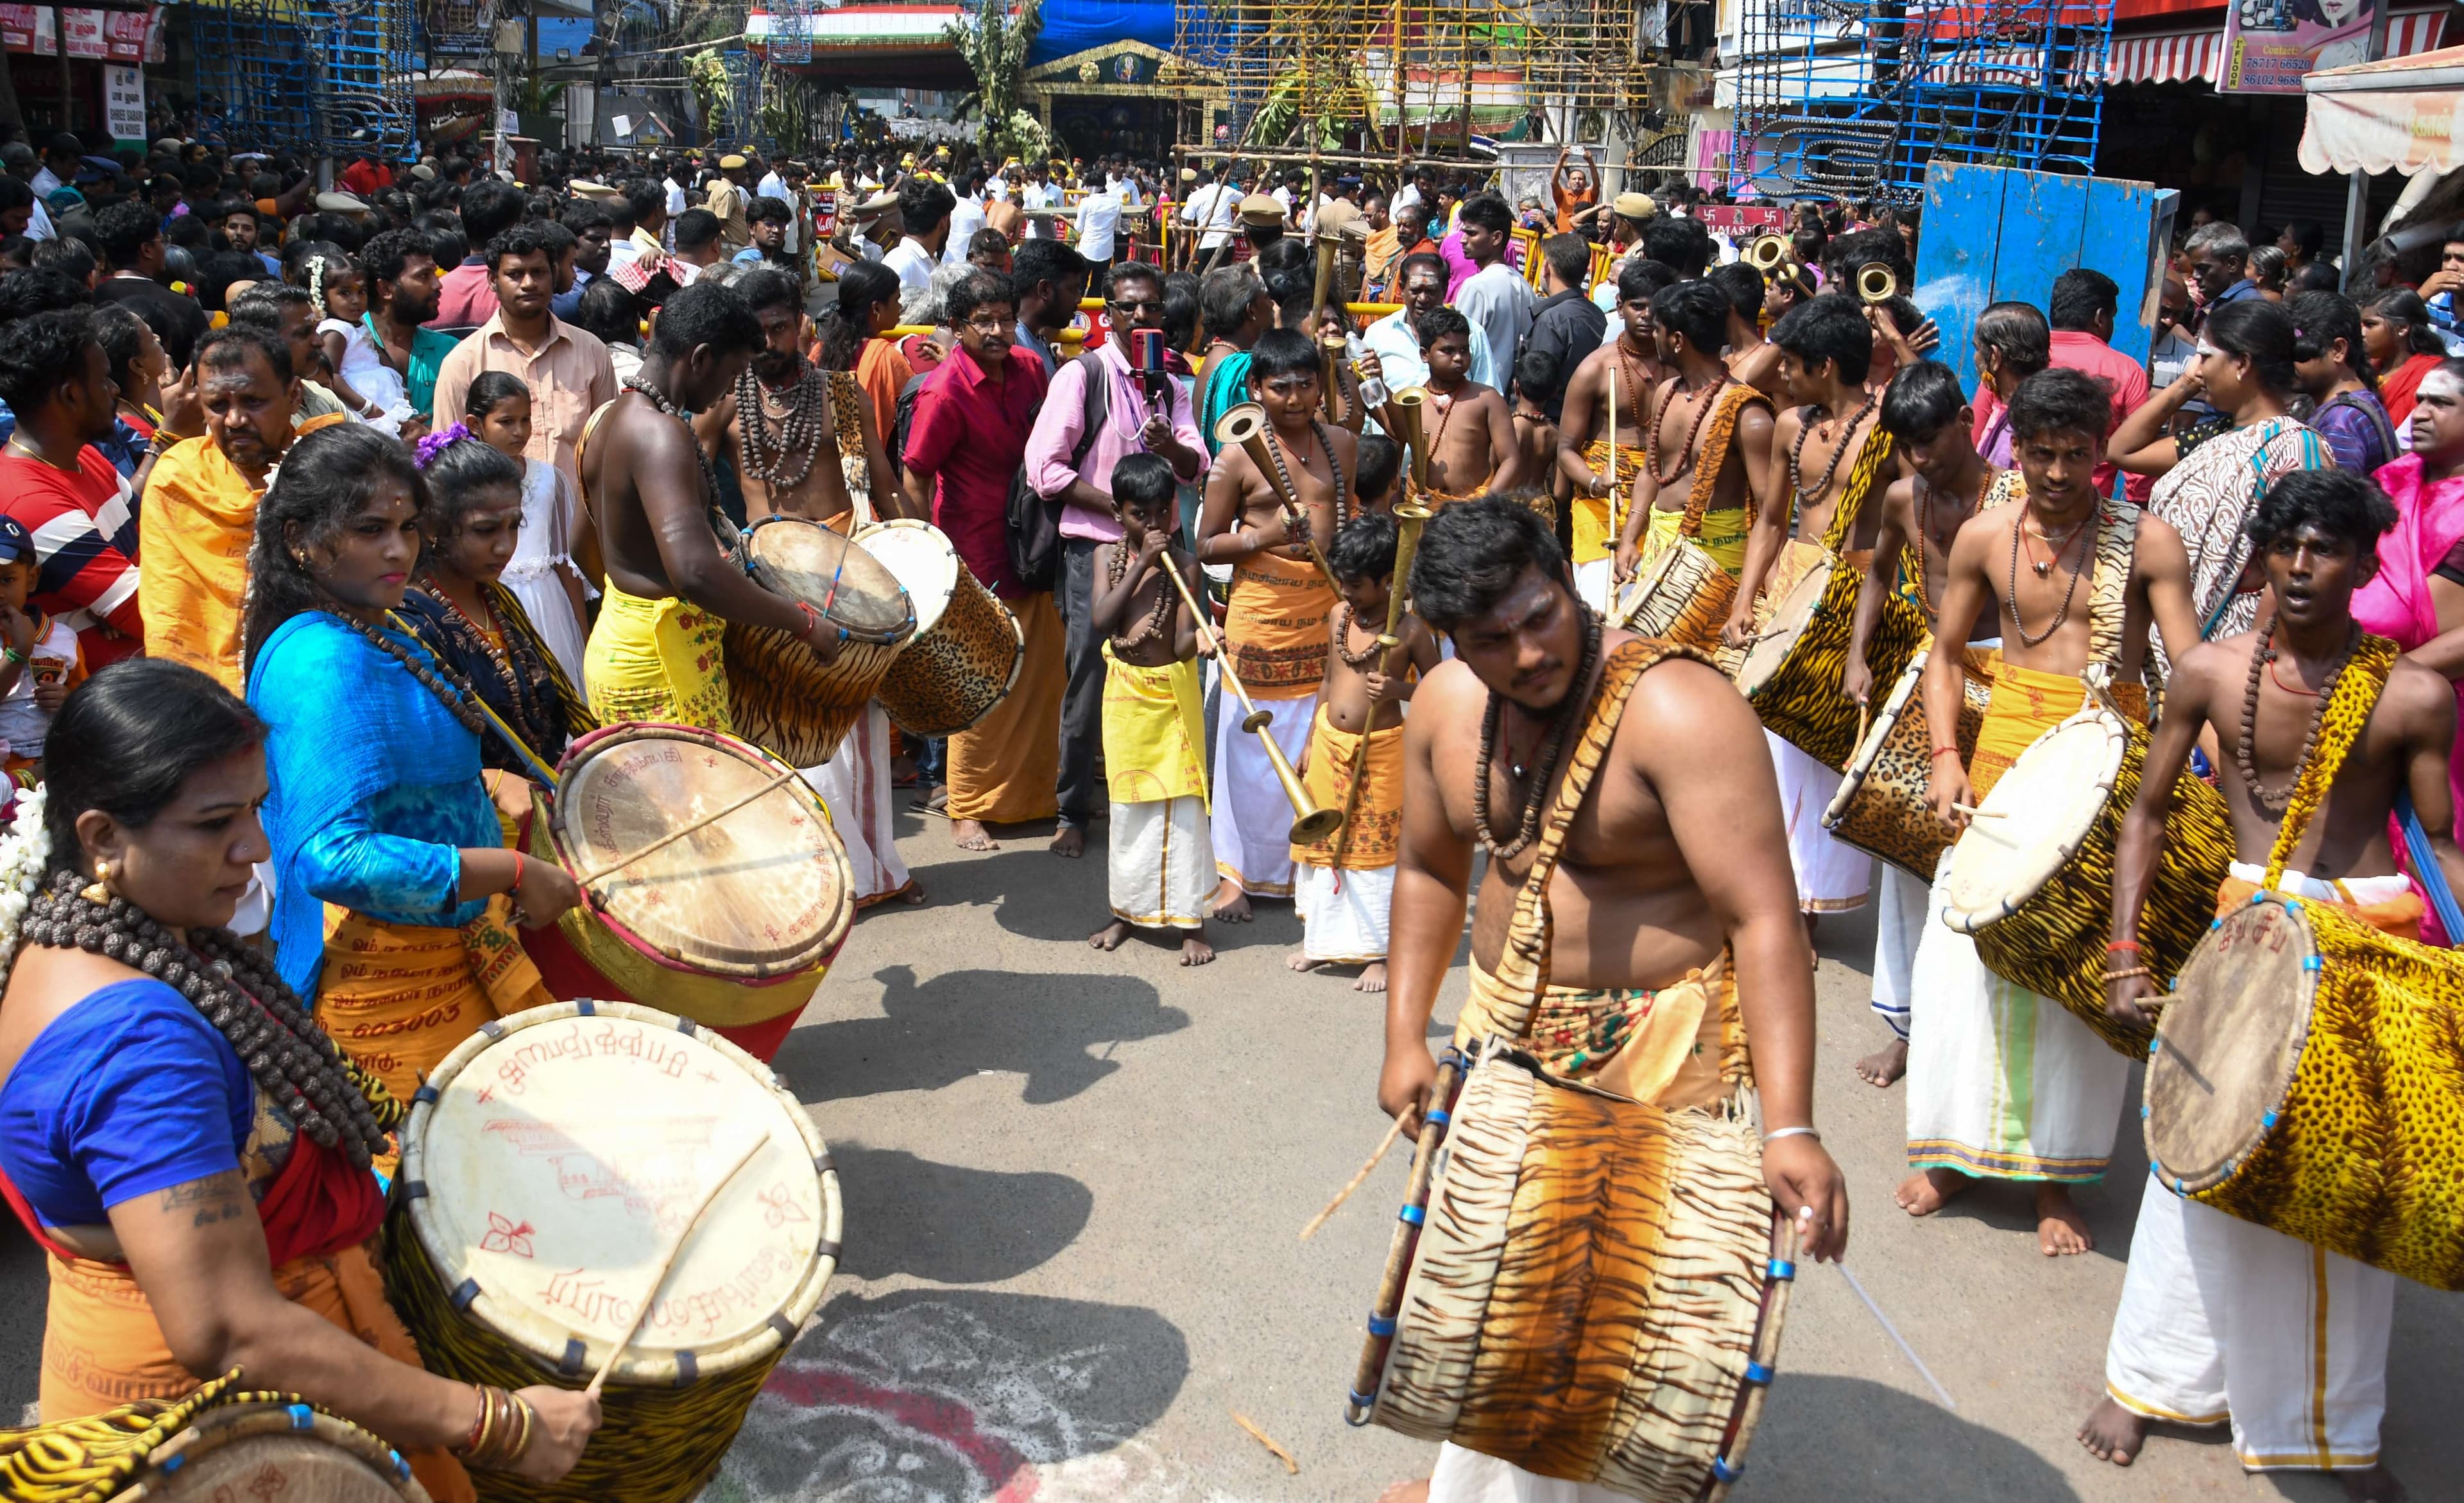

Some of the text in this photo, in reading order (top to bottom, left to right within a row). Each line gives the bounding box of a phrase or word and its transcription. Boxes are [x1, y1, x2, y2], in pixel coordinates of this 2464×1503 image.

[2263, 46, 2298, 55] Contact:
[2230, 50, 2240, 86] FLOOR
[2246, 58, 2311, 70] 78717 66520
[2243, 74, 2302, 87] 86102 9686
[110, 108, 143, 121] SHREE SABARI
[114, 123, 141, 135] PAN HOUSE
[1720, 225, 1783, 236] MASTR'S
[1239, 568, 1303, 587] நமசிவாய
[1295, 618, 1317, 629] நம
[31, 658, 64, 668] FORCE
[340, 962, 367, 979] ஓம்
